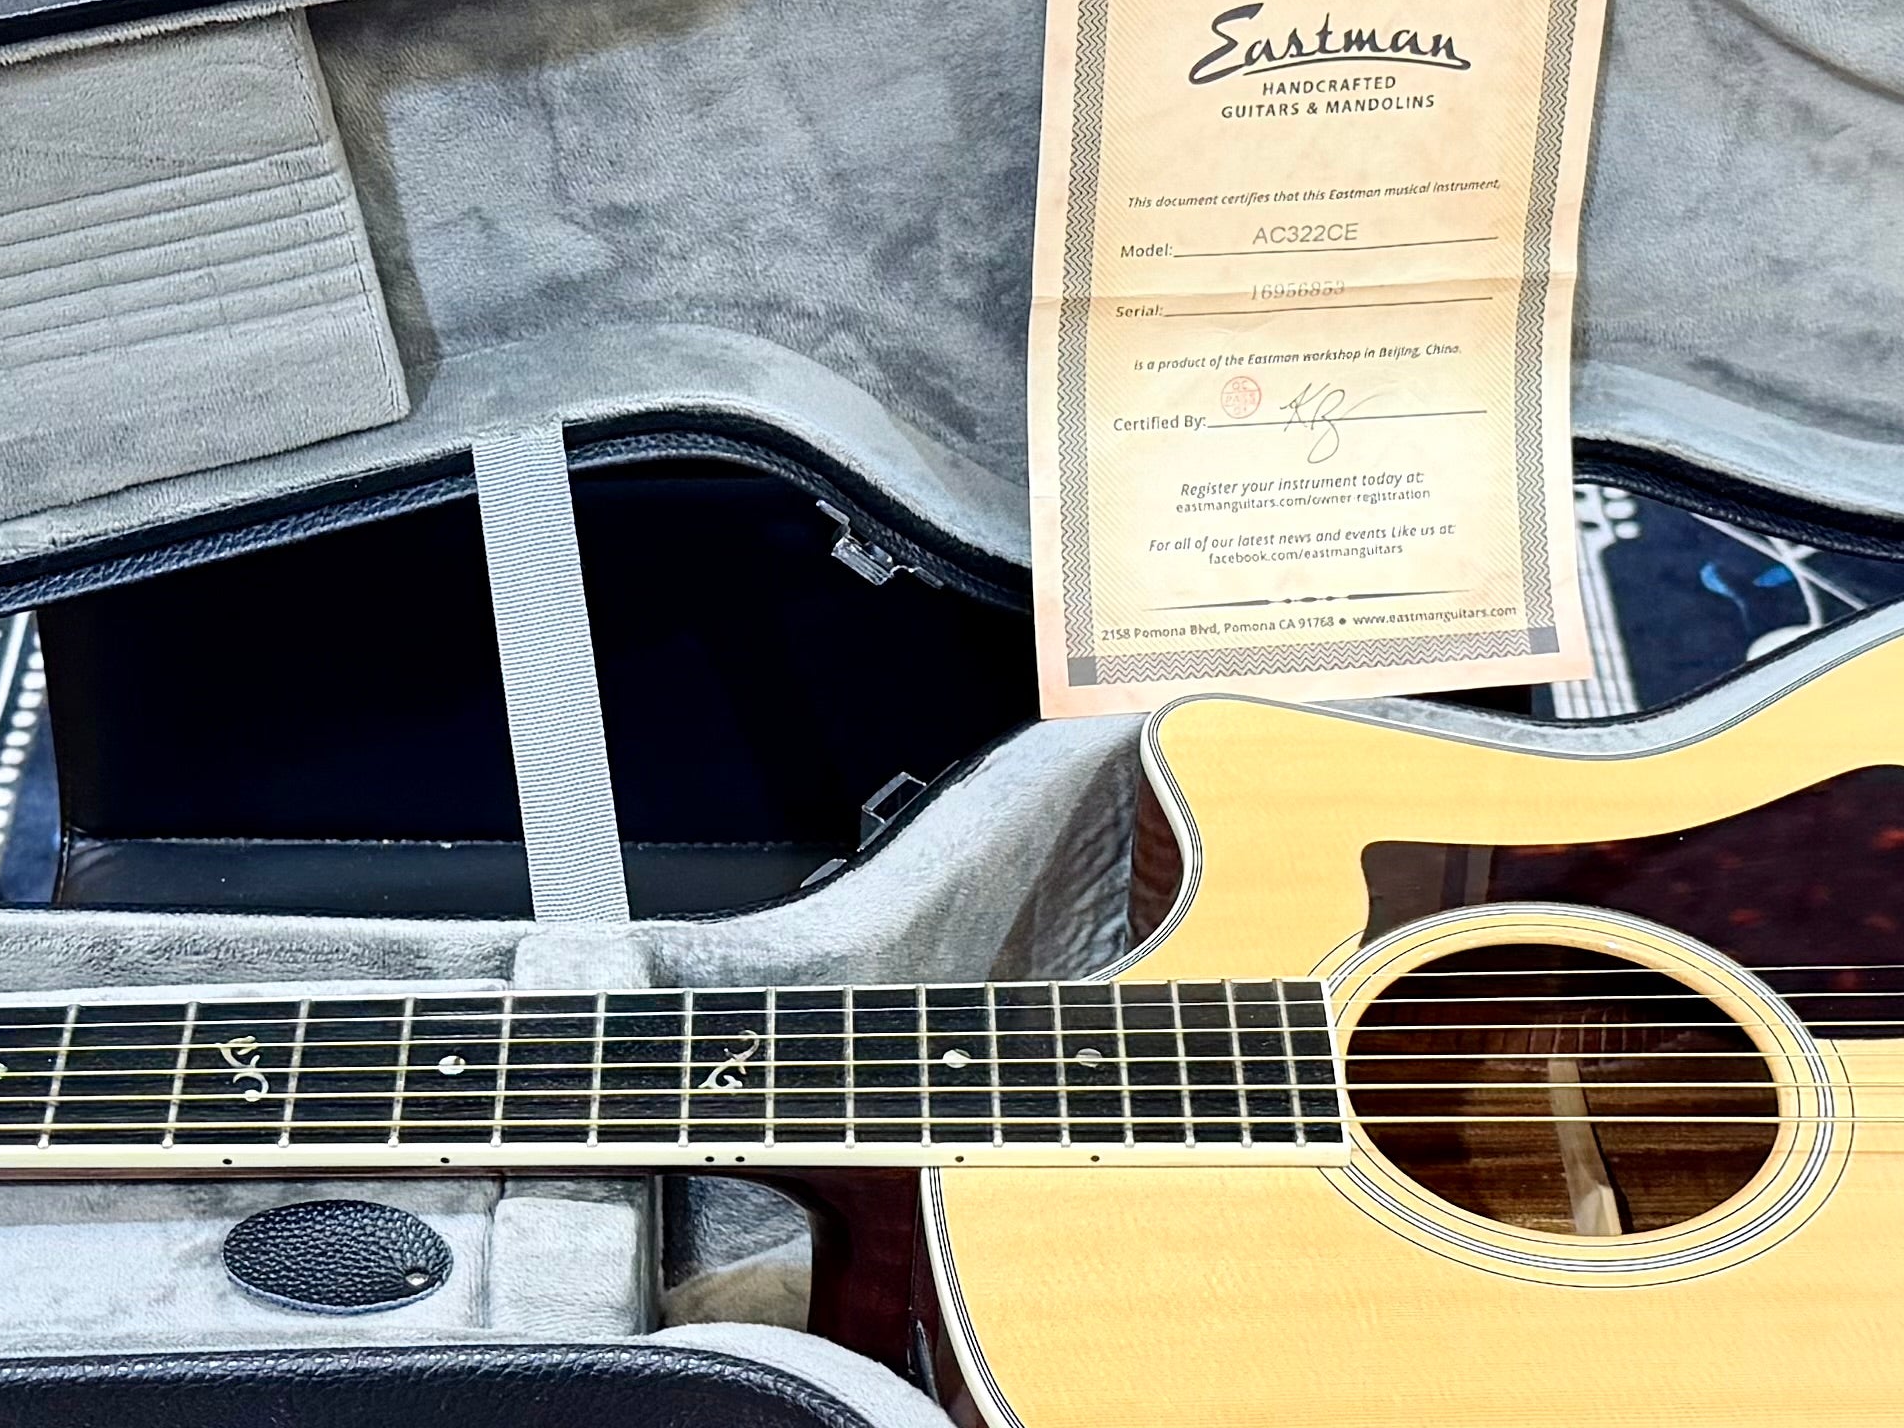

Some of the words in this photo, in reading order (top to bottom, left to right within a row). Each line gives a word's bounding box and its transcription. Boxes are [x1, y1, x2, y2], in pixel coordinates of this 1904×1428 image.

[1188, 2, 1472, 85] Eastman
[1262, 75, 1397, 96] HANDCRAFTED
[1221, 102, 1300, 120] GUITARS
[1306, 102, 1318, 115] &
[1325, 94, 1435, 116] MANDOLINS
[1128, 196, 1152, 209] This
[1155, 194, 1218, 208] document
[1221, 191, 1270, 207] certifies
[1273, 190, 1299, 203] that
[1302, 188, 1325, 202] this
[1328, 187, 1381, 201] Eastman
[1384, 181, 1431, 197] musical
[1120, 243, 1173, 259] Model:
[1252, 222, 1359, 246] AC322CE
[1115, 304, 1164, 318] Serial:
[1134, 359, 1143, 371] is
[1147, 360, 1155, 370] a
[1157, 357, 1206, 373] product
[1209, 355, 1224, 371] of
[1225, 354, 1245, 367] the
[1247, 353, 1300, 366] Eastman
[1302, 348, 1361, 362] workshop
[1364, 347, 1376, 359] in
[1113, 414, 1180, 431] Certified
[1183, 414, 1206, 432] By:
[1180, 481, 1238, 499] Register
[1241, 480, 1275, 497] your
[1278, 475, 1357, 491] instrument
[1362, 471, 1403, 489] today
[1149, 539, 1171, 552] For
[1174, 537, 1191, 550] all
[1194, 535, 1209, 553] of
[1211, 537, 1234, 549] our
[1237, 534, 1275, 547] latest
[1278, 533, 1312, 545] news
[1316, 528, 1342, 542] and
[1345, 527, 1387, 541] events
[1420, 525, 1435, 536] us
[1208, 544, 1404, 565] facebook.com/eastmanguitars
[1134, 626, 1187, 639] Pomona
[1224, 621, 1276, 634] Pomona
[1279, 618, 1296, 630] CA
[1352, 605, 1518, 626] www.eastmanguitars.com
